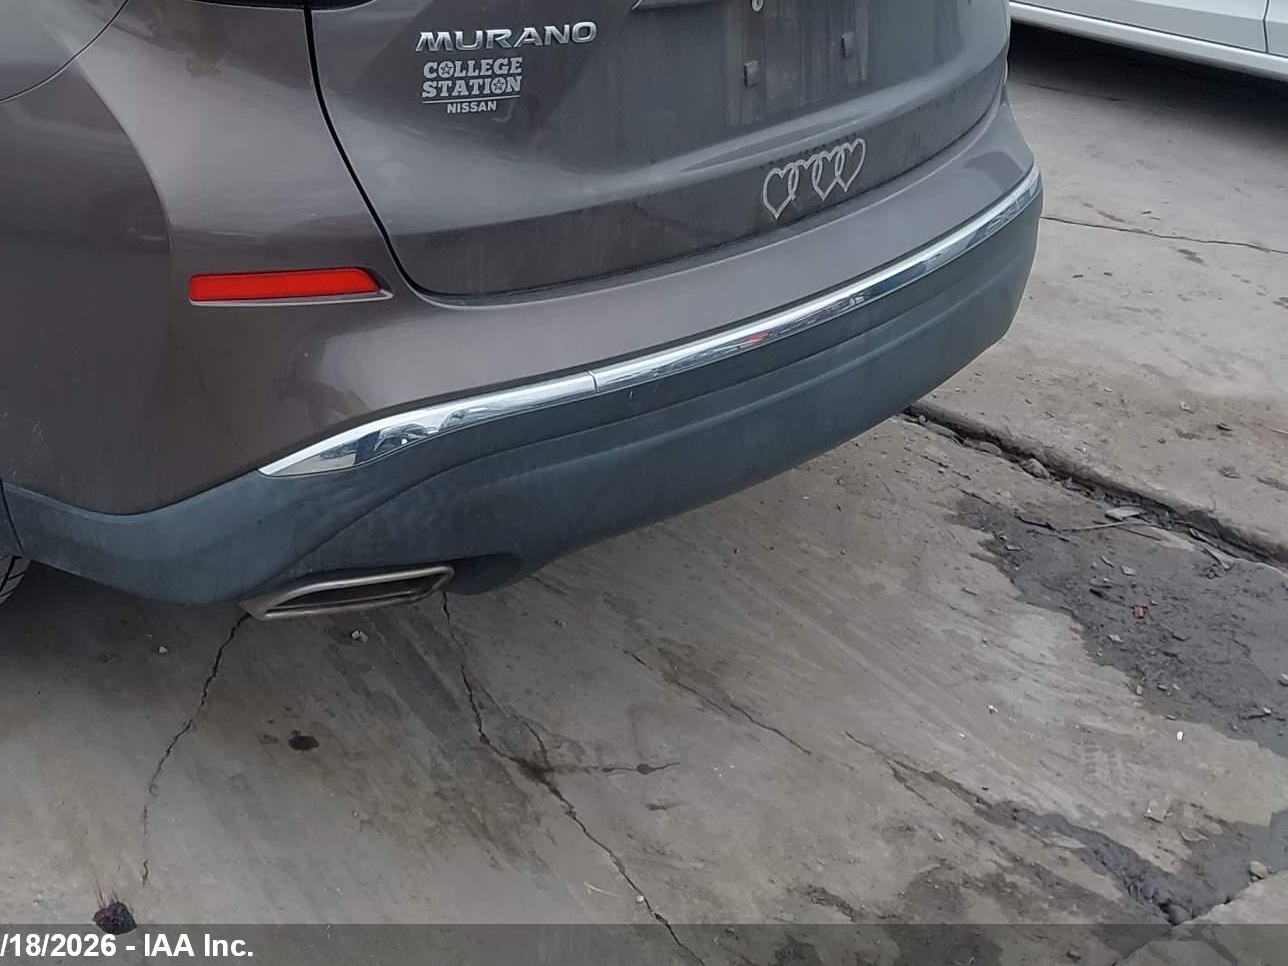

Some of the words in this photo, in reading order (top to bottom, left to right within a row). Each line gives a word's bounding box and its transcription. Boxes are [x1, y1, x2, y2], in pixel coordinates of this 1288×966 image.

[415, 21, 597, 52] MURANO
[423, 57, 523, 78] COLLEGE
[422, 75, 522, 98] STATION
[446, 100, 497, 115] NISSAN
